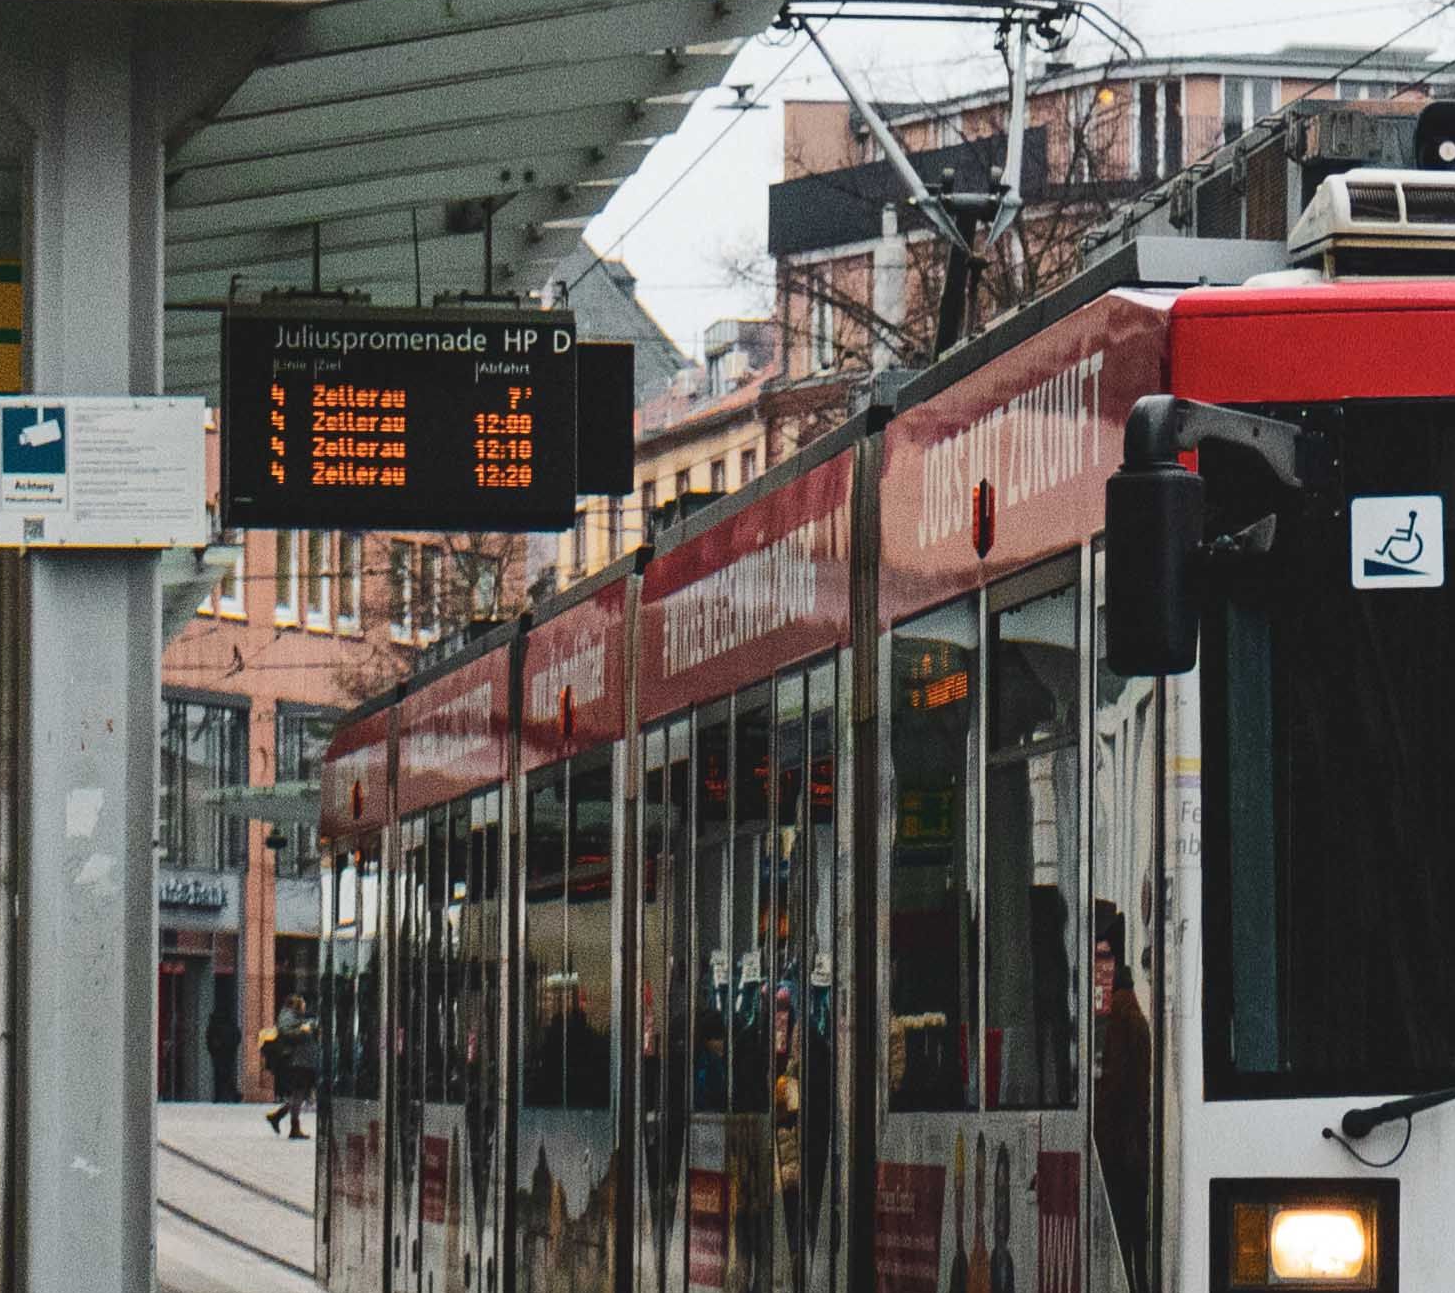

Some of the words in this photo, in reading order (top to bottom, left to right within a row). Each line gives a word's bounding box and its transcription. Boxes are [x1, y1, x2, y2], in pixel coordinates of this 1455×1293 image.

[274, 324, 488, 355] Juliuspromenade
[504, 328, 538, 352] HP
[553, 329, 572, 354] D
[478, 362, 531, 375] Abfahrt
[311, 384, 407, 409] Zellerau
[311, 410, 407, 433] Zellerau
[311, 436, 407, 459] Zellerau
[917, 427, 965, 551] JOBS
[1007, 349, 1105, 508] ZUKUNFT
[311, 460, 407, 487] Zellerau
